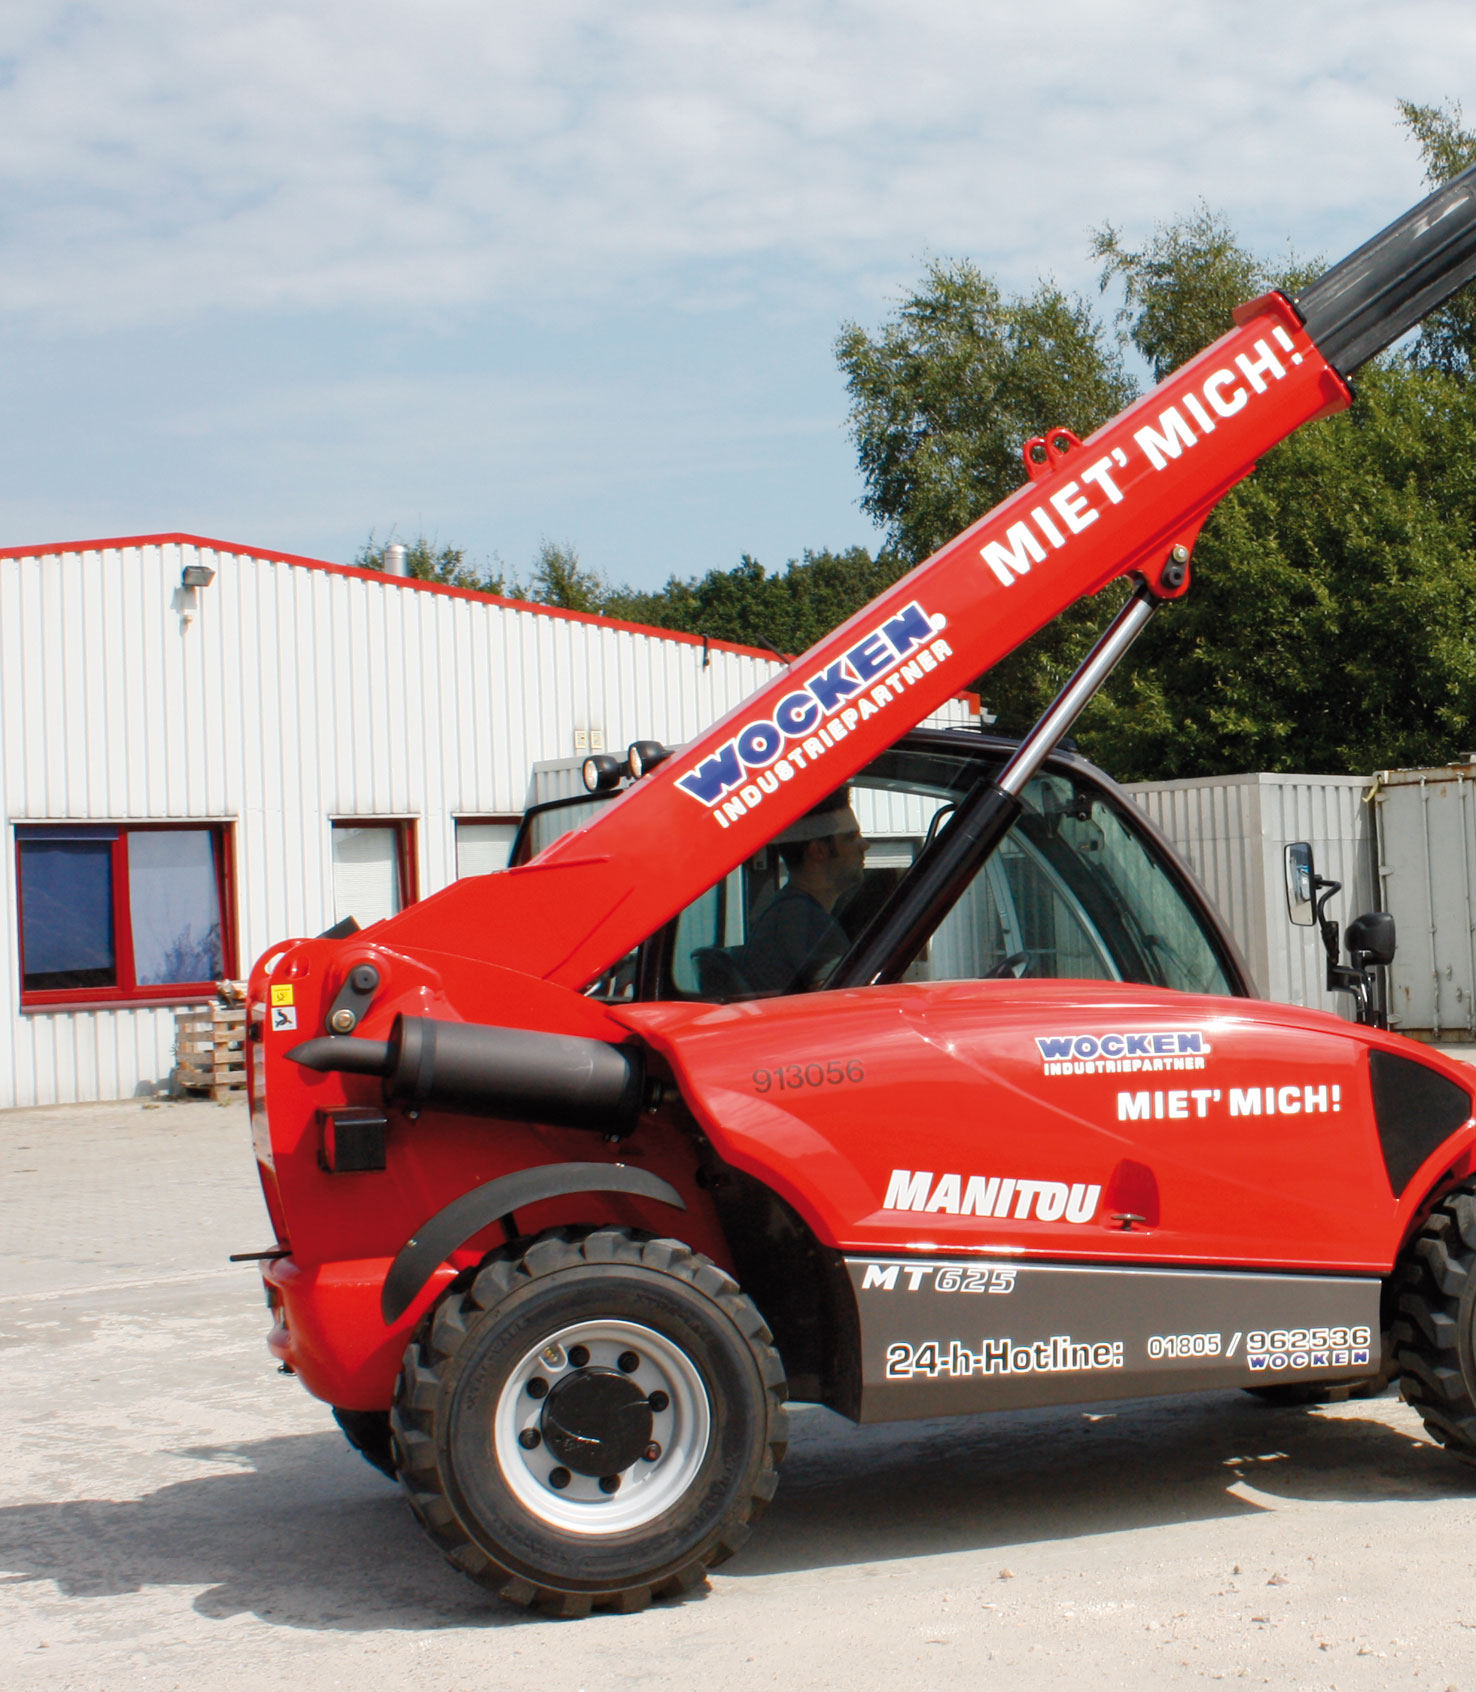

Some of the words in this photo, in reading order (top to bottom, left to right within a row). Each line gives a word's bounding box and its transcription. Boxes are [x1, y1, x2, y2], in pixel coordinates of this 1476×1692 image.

[980, 447, 1128, 587] MIET'
[1133, 326, 1304, 471] MICH!
[713, 639, 953, 829] INDUSTRIEPARTNER
[752, 1059, 864, 1093] 913056
[1043, 1057, 1205, 1076] INDUSTRIEPARTNER
[1117, 1089, 1221, 1121] MIET'
[1229, 1084, 1341, 1116] MICH!
[883, 1169, 1101, 1223] MANITOU
[1148, 1333, 1221, 1358] 01805
[1247, 1326, 1371, 1353] 962536
[1247, 1348, 1370, 1371] WOCKEN
